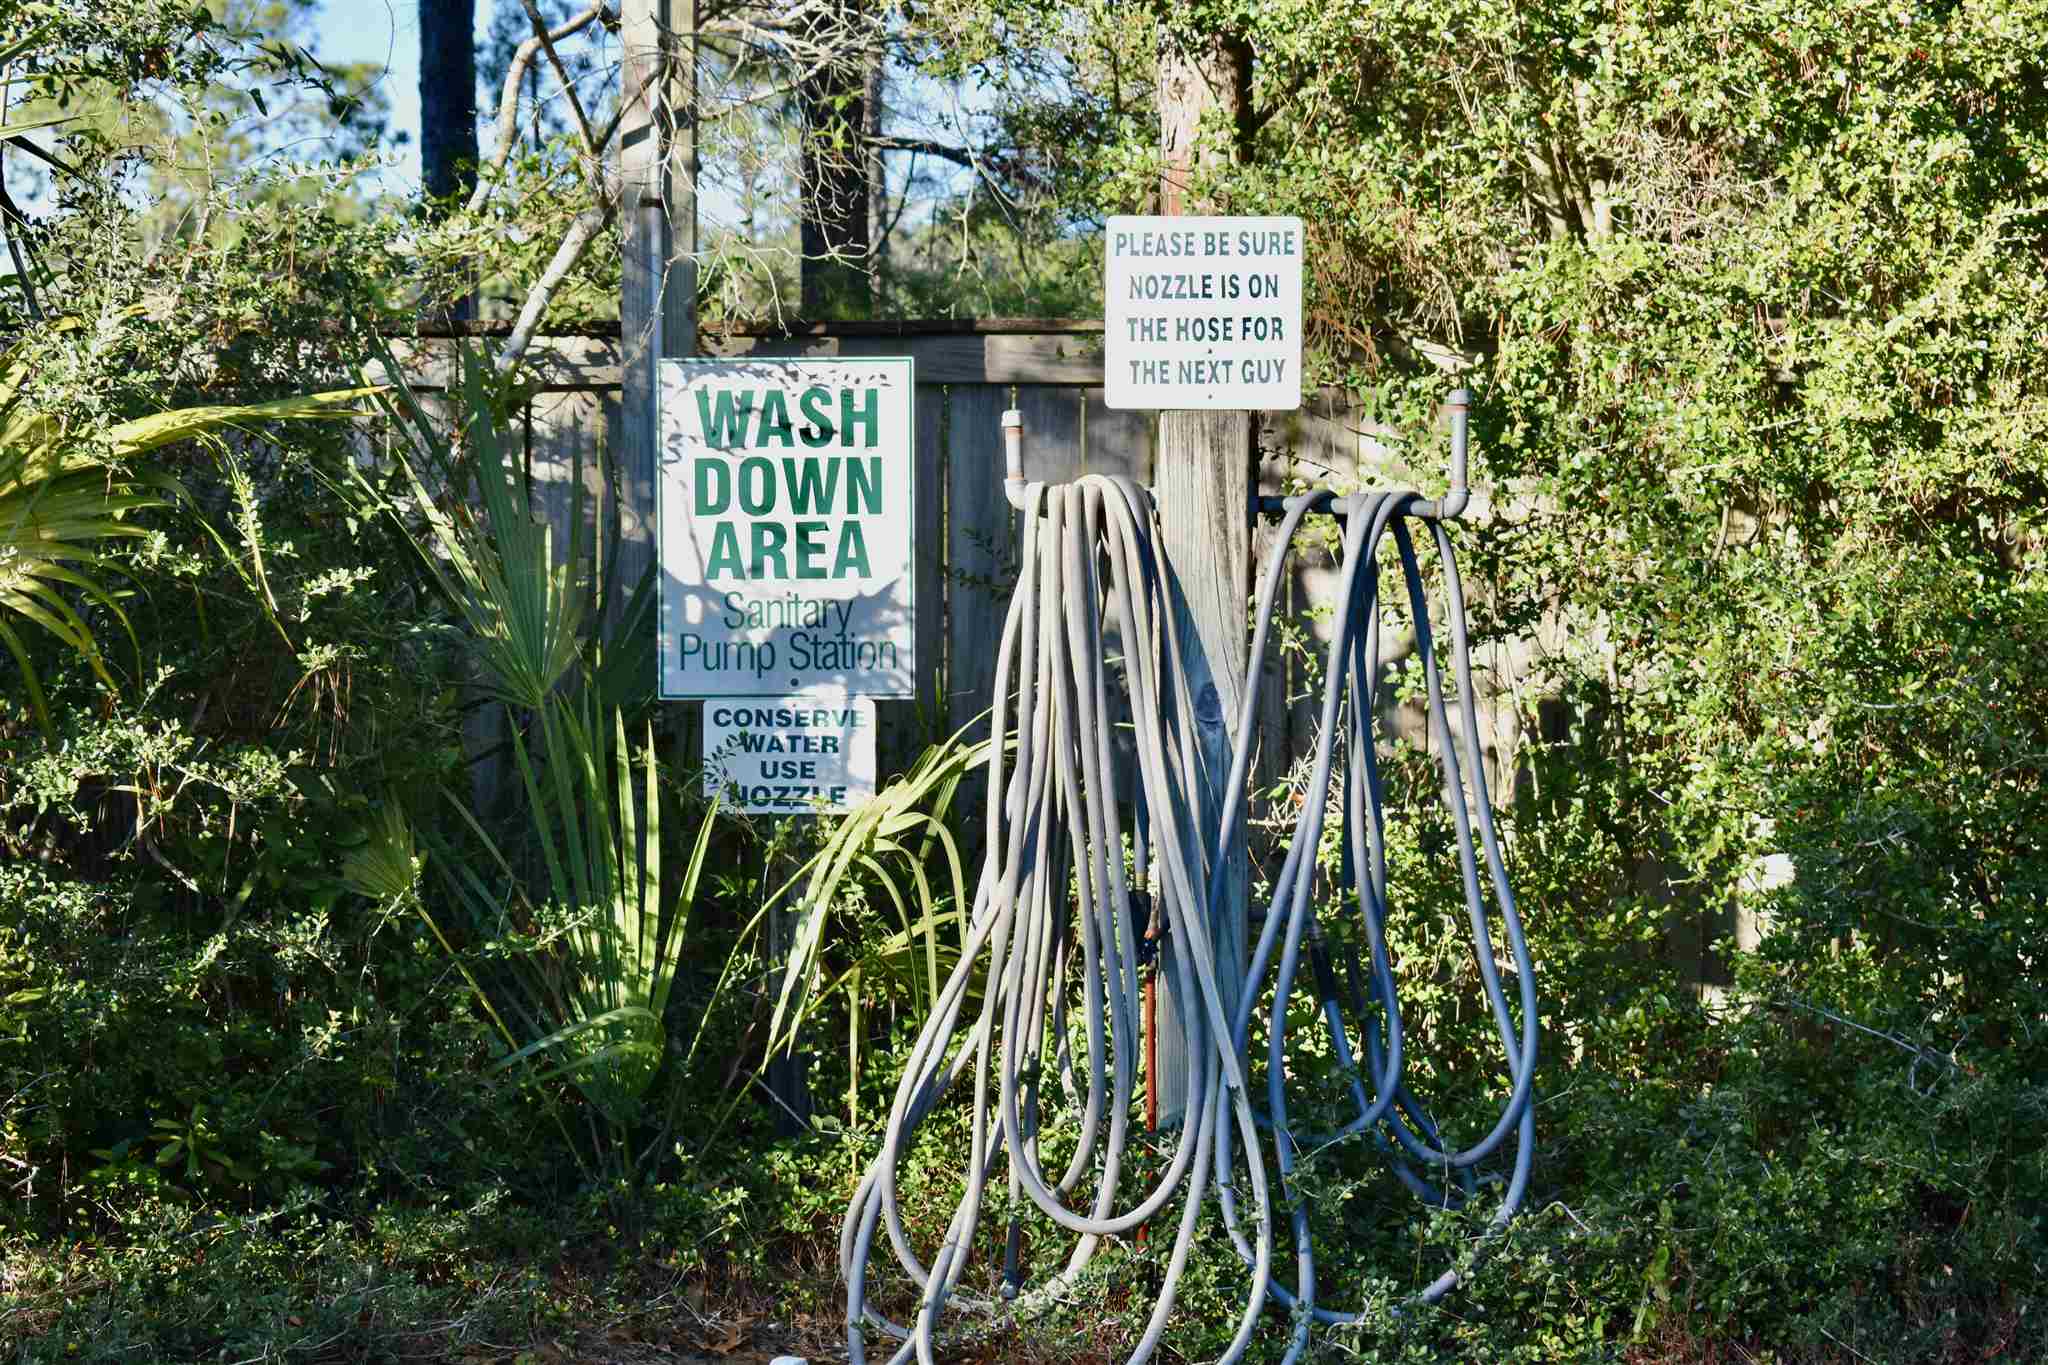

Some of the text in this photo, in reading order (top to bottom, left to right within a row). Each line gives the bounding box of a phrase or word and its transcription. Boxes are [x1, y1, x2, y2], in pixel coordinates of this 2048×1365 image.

[1115, 231, 1295, 256] PLEASE BE SURE
[1129, 274, 1278, 299] NOZZLE IS ON
[1127, 317, 1283, 341] THE HOSE FOR
[1129, 359, 1286, 384] THE NEXT GUY
[694, 387, 879, 449] WASH
[694, 456, 883, 516] DOWN
[704, 521, 872, 580] AREA
[724, 592, 853, 636] Sanitary
[680, 633, 897, 678] Pump Station
[713, 709, 866, 727] CONSERVE
[743, 734, 838, 753] WATER
[761, 761, 816, 779] USE
